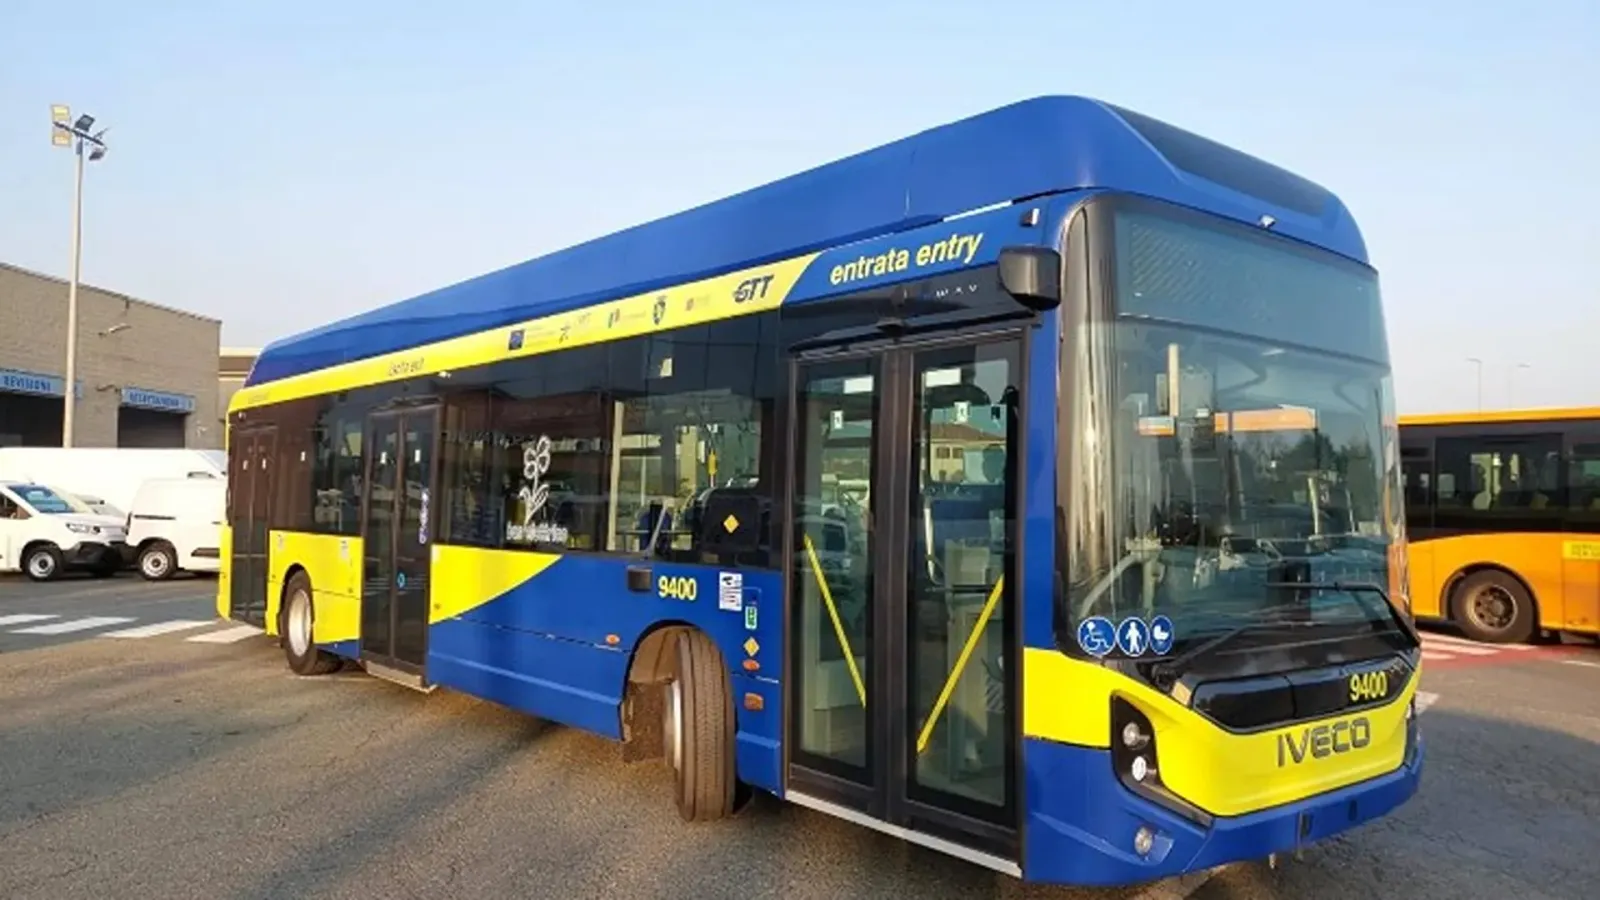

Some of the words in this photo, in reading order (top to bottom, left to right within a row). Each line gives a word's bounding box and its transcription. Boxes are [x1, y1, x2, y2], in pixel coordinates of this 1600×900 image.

[830, 248, 909, 285] entrata
[915, 233, 983, 264] entry
[733, 274, 775, 303] GTT
[659, 575, 697, 600] 9400
[1350, 671, 1388, 701] 9400
[1277, 717, 1371, 767] IVECO
